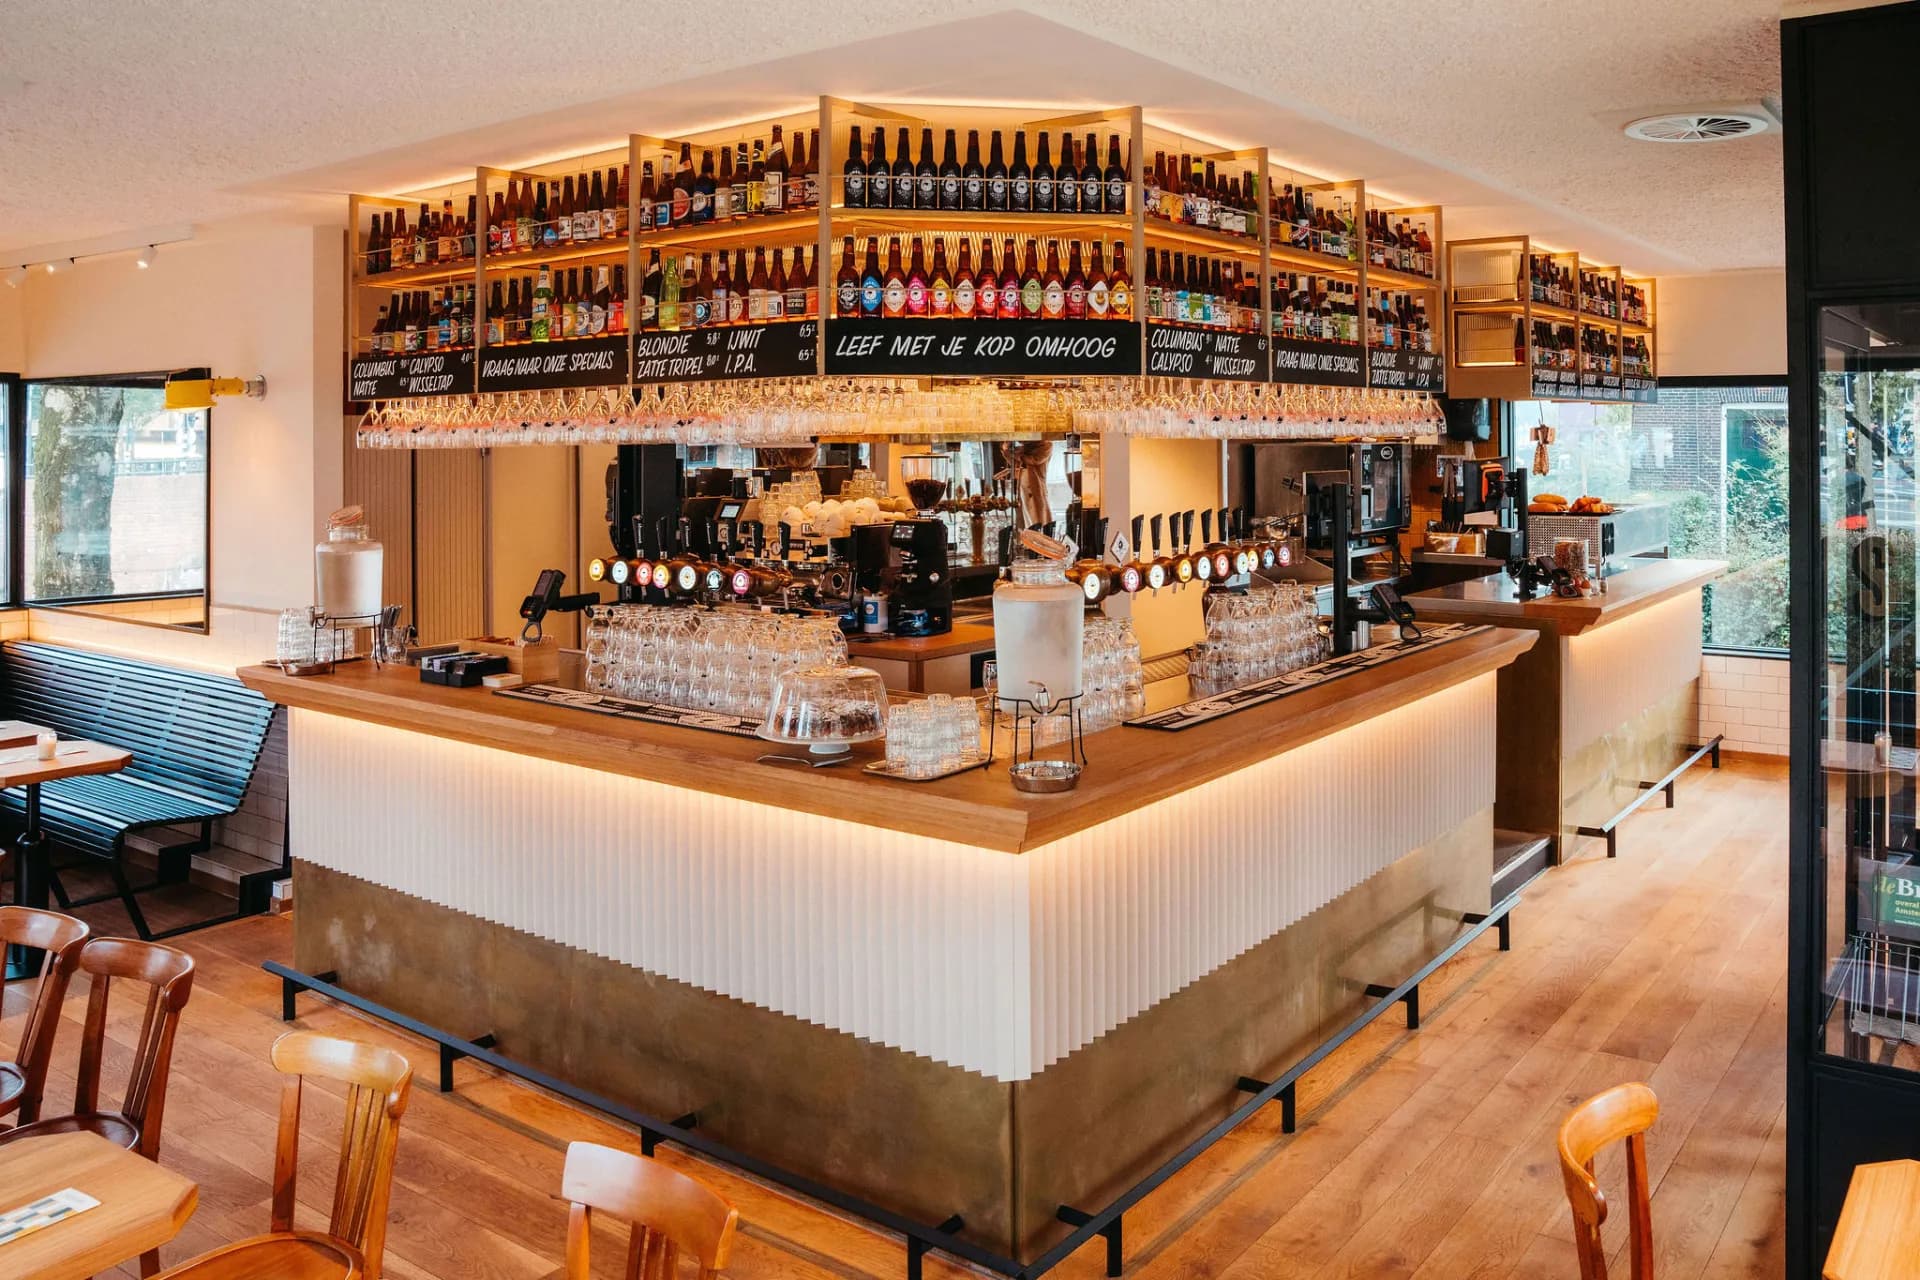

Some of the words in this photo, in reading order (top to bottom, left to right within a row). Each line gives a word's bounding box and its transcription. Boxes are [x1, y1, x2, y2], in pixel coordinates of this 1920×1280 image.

[638, 334, 692, 357] BLONDIE
[727, 328, 766, 351] IJWIT
[835, 334, 884, 357] LEEF
[889, 335, 935, 357] MET
[941, 336, 967, 357] JE
[974, 335, 1016, 357] KOP
[1025, 335, 1117, 358] OMHOOG
[1150, 328, 1205, 351] COLUMBUS
[1215, 334, 1241, 353] NATTE
[353, 360, 397, 379] COLUMBUS
[409, 356, 445, 375] CALYPSO
[482, 359, 515, 378] VRAAG
[514, 356, 543, 375] NAAR
[542, 354, 569, 374] ONZE
[569, 351, 614, 372] SPECIALS
[637, 359, 665, 379] ZATTE
[667, 356, 704, 377] TRIPEL
[724, 353, 757, 374] I.P.A.
[1150, 351, 1193, 373] CALYPSO
[1213, 355, 1256, 376] WISSELTAP
[1276, 350, 1299, 368] VRAAG
[1299, 351, 1317, 370] NAAR
[1317, 354, 1333, 371] ONZE
[1333, 356, 1359, 374] SPECIALS
[1371, 351, 1398, 368] BLONDIE
[353, 379, 378, 397] NATTE
[408, 374, 454, 393] WISSELTAP
[1371, 369, 1389, 385] ZATTE
